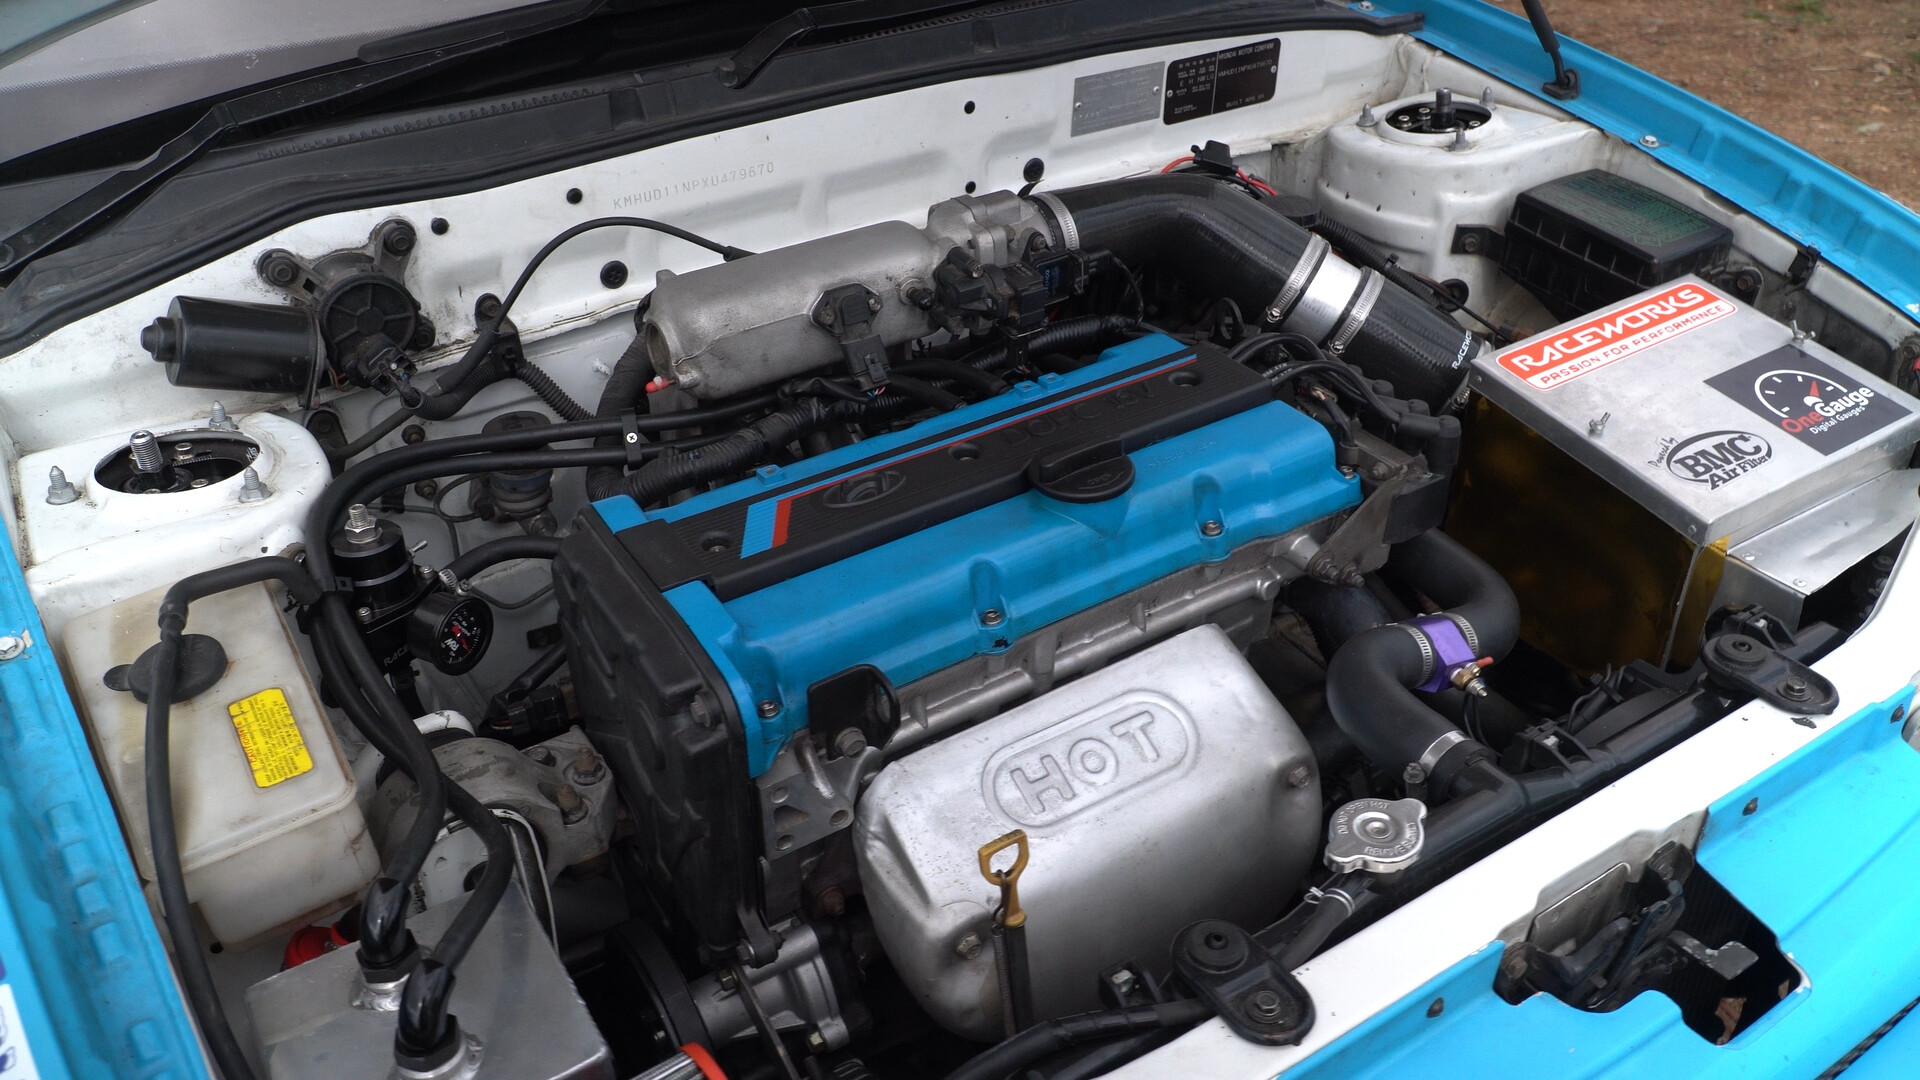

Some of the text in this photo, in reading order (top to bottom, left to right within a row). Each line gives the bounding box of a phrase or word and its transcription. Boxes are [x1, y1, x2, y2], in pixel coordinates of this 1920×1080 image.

[613, 162, 774, 210] KMHUD11NPXU479670
[1511, 289, 1705, 372] RACEWORKS
[1540, 305, 1725, 385] PASSION FOR PERFORMANCE
[1809, 405, 1866, 435] Digital Gauges
[1647, 441, 1671, 467] Powered
[1673, 434, 1762, 478] BMC
[1709, 455, 1768, 490] Air Filter
[1010, 710, 1161, 815] HOT
